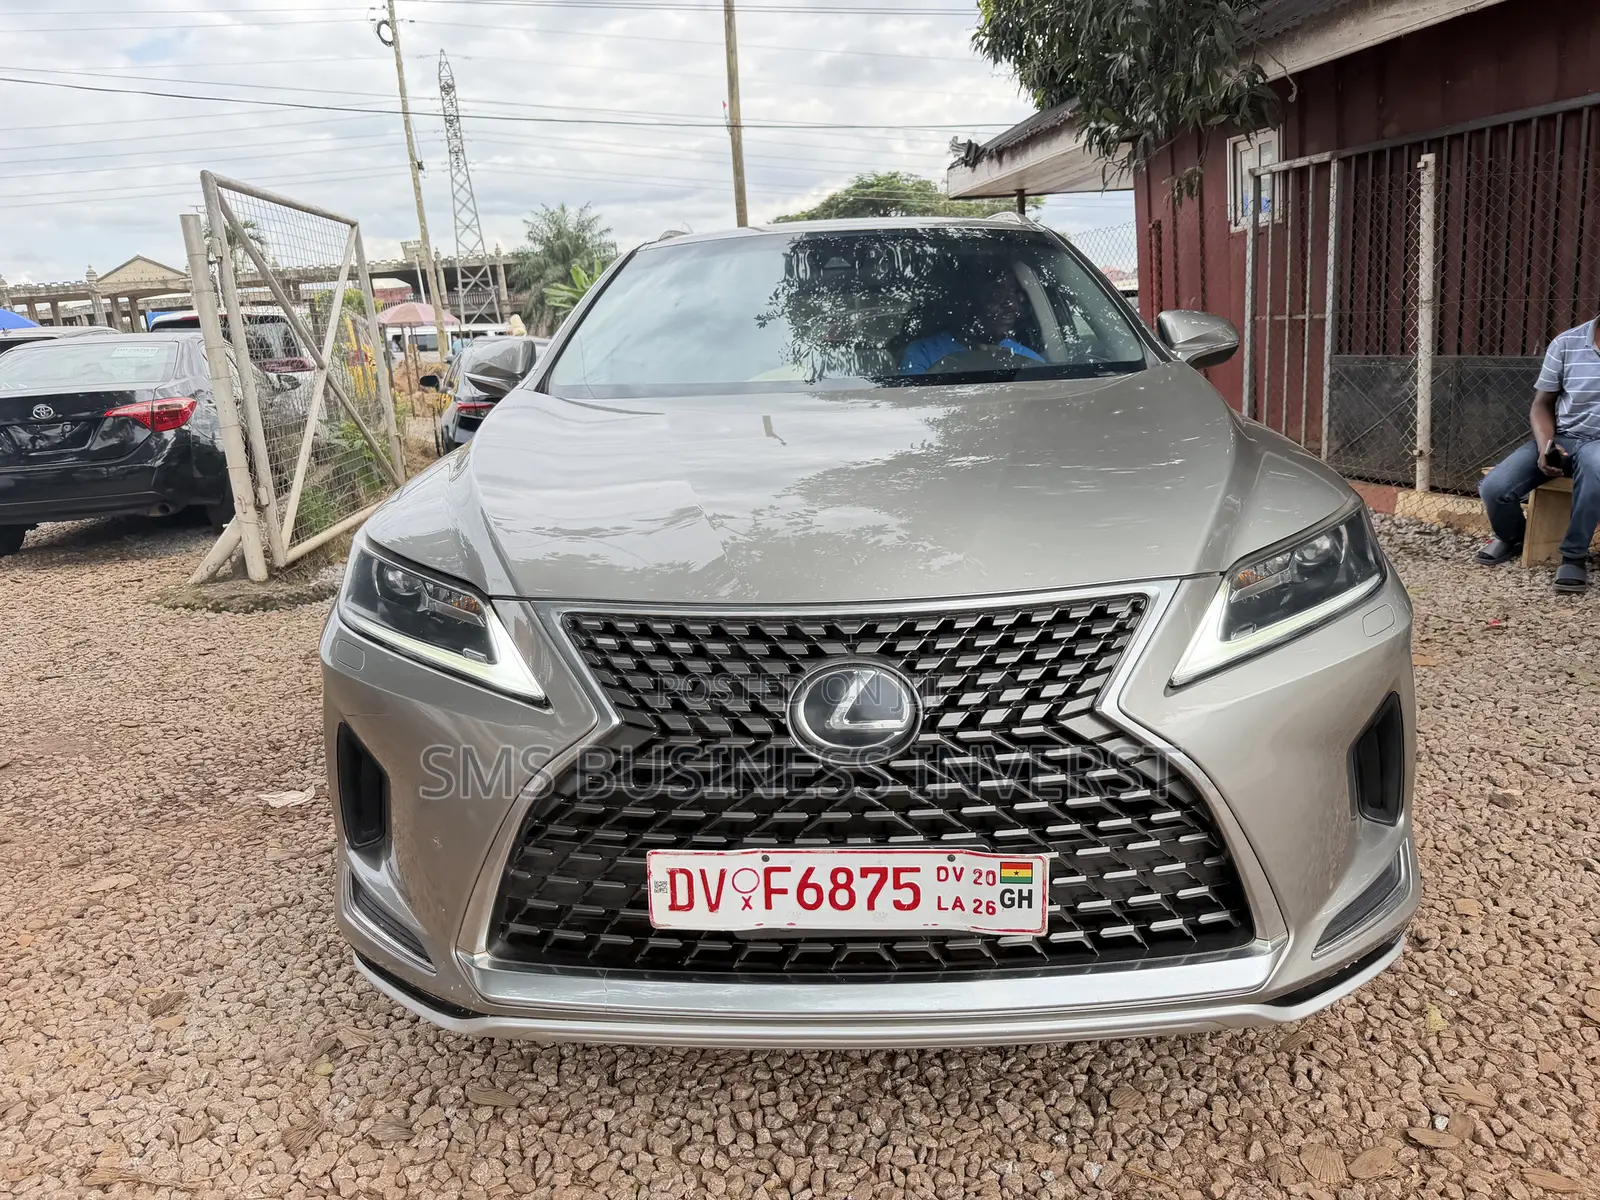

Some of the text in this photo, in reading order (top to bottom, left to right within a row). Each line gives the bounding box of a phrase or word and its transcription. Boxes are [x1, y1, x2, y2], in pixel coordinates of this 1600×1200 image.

[937, 866, 997, 886] DV 20
[666, 867, 727, 913] DV
[763, 866, 921, 911] F6875
[1000, 888, 1034, 909] GH
[937, 895, 997, 915] LA 26
